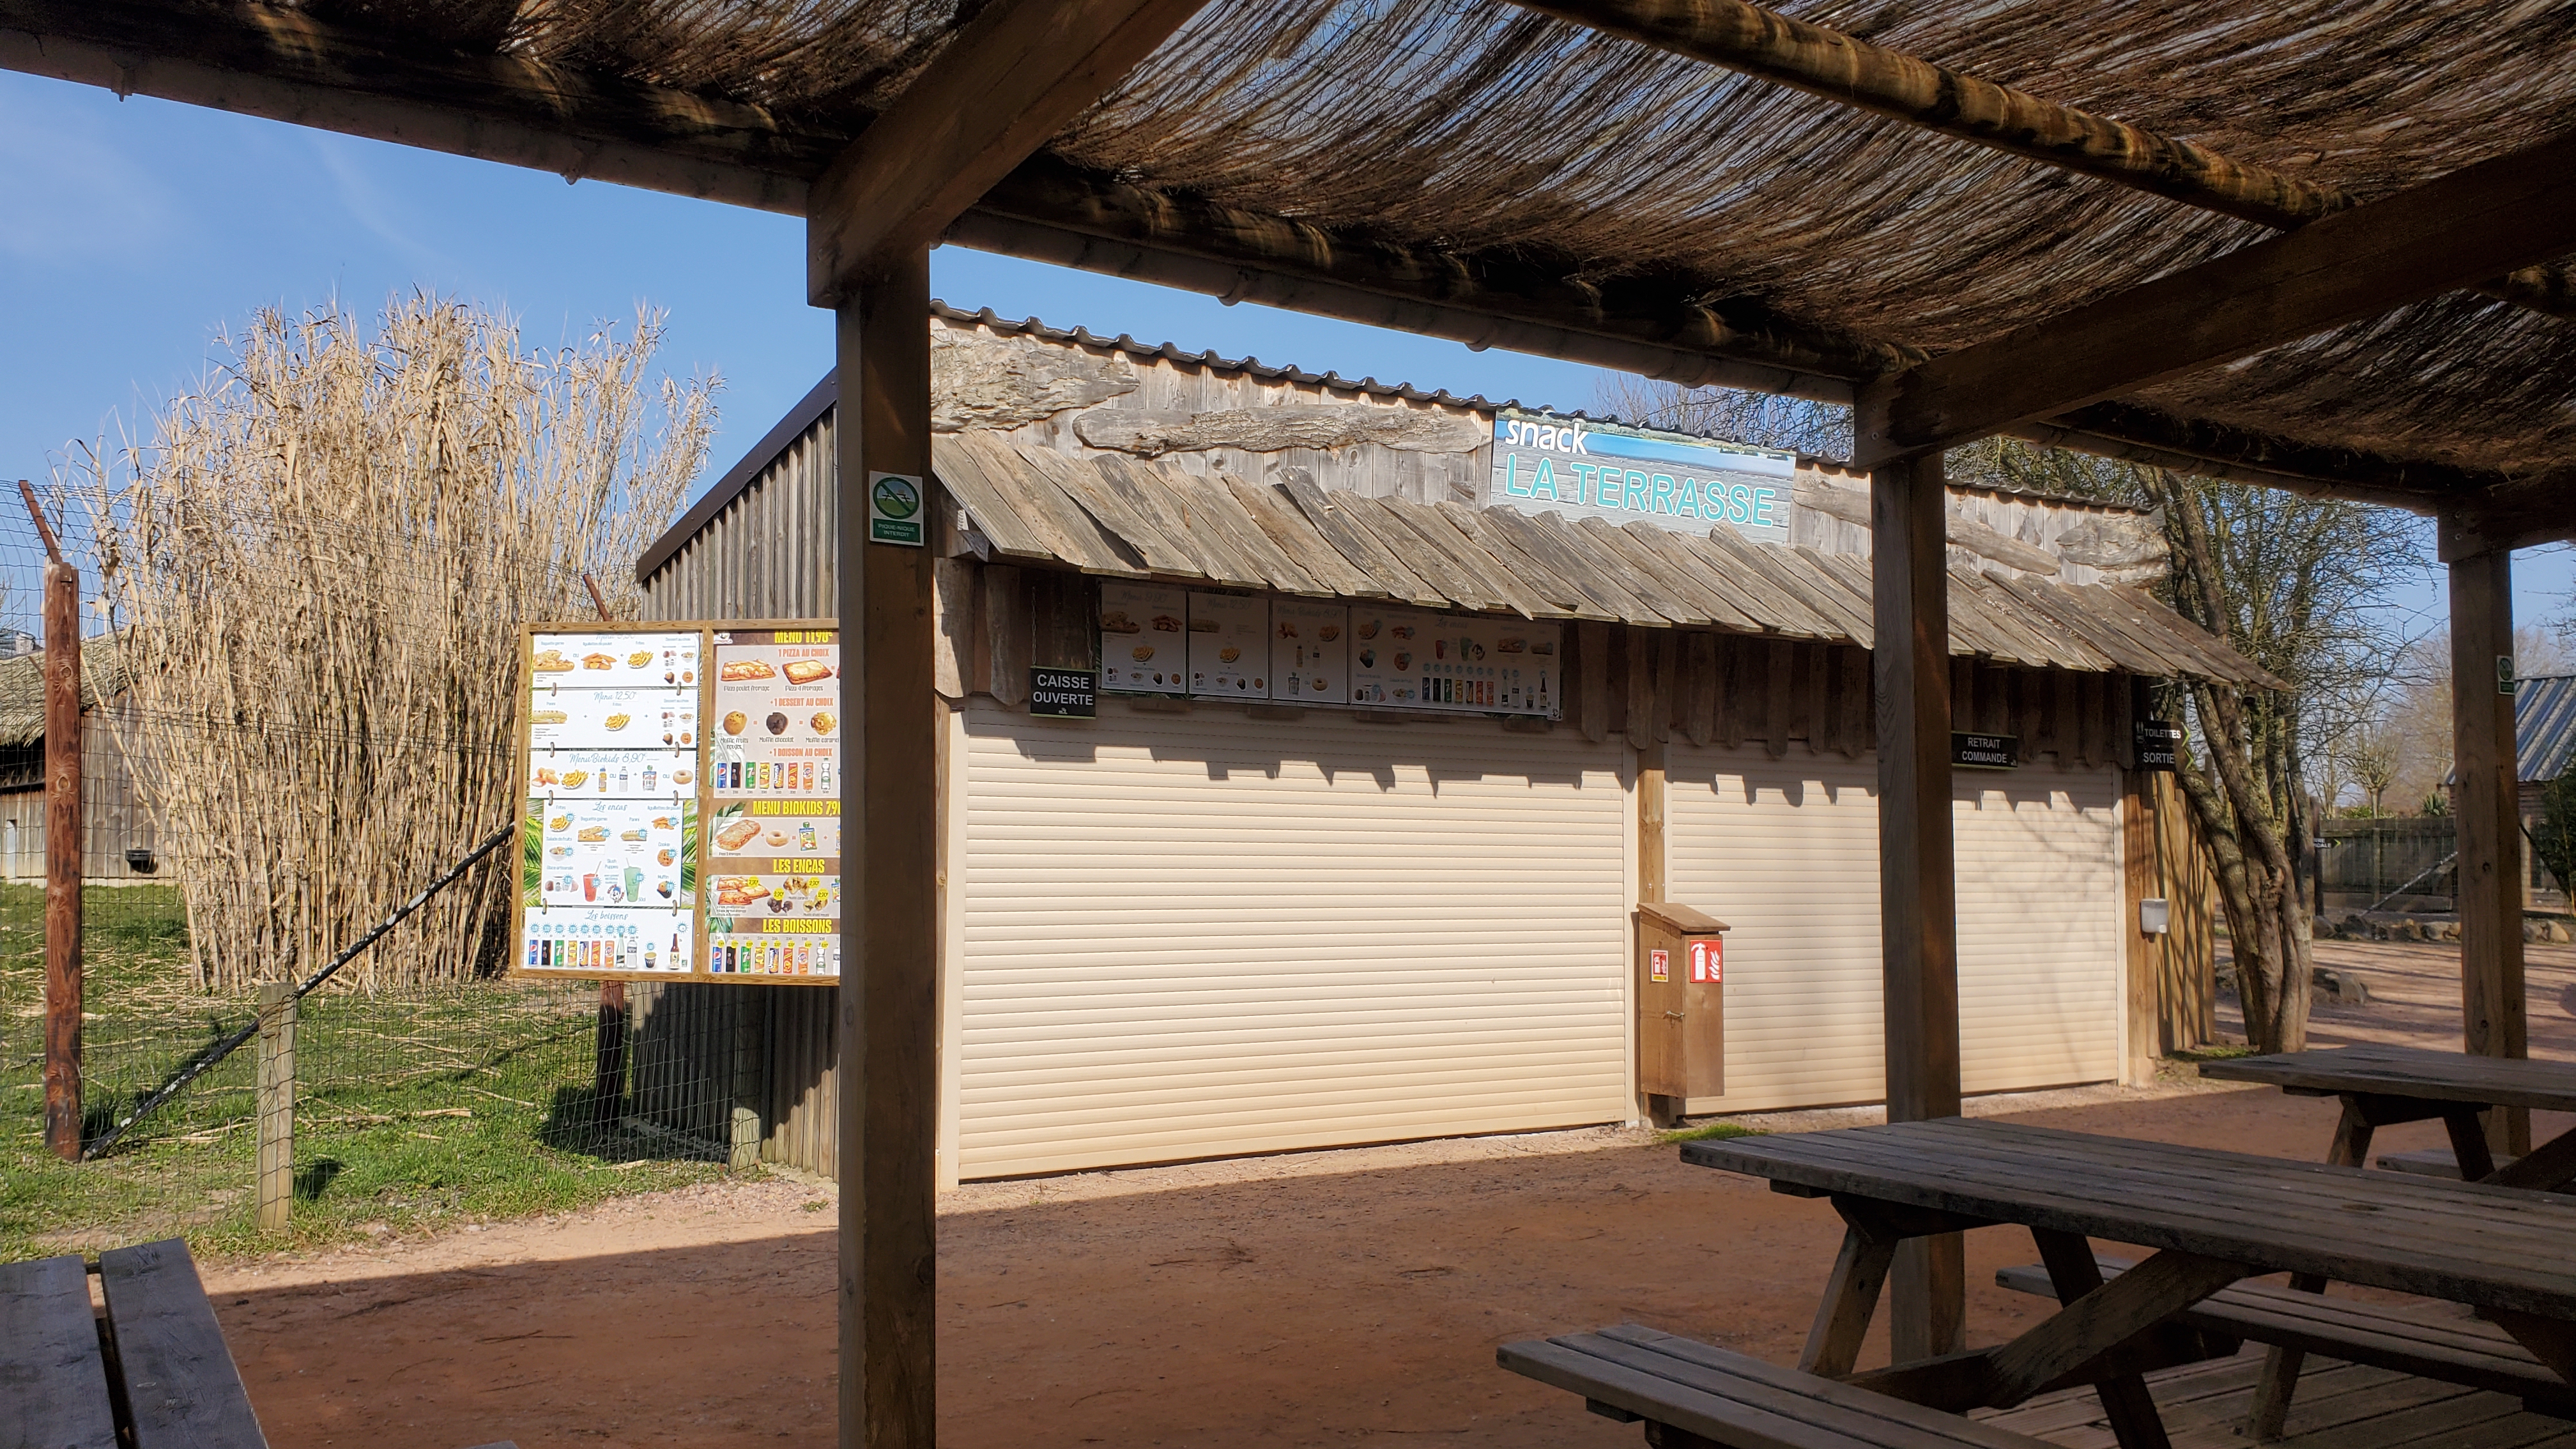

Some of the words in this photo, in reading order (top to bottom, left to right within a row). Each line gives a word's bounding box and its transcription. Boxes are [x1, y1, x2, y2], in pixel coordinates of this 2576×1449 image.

[1505, 419, 1589, 456] snack
[1505, 453, 1560, 502] LA
[1570, 462, 1776, 528] TERRASSE
[878, 523, 916, 532] PIQUE-NIQUE
[774, 630, 802, 643] MENU
[783, 648, 800, 657] PIZZA
[802, 648, 810, 657] AU
[811, 648, 829, 657] CHOIX
[1037, 674, 1089, 689] CAISSE
[594, 691, 614, 703] Menu
[779, 698, 804, 707] DESSERT
[806, 698, 814, 707] AU
[815, 698, 834, 707] CHOIX
[1032, 691, 1094, 705] OUVERTE
[2144, 728, 2182, 739] TOILETTES
[1968, 737, 2001, 749] RETRAIT
[778, 748, 804, 757] BOISSON
[804, 748, 813, 757] AU
[814, 748, 832, 757] CHOIX
[1961, 751, 2008, 763] COMMANDE
[2143, 752, 2175, 764] SORTIE
[569, 753, 590, 767] Menu
[591, 753, 620, 763] Biokids
[592, 801, 607, 813] Les
[607, 804, 627, 812] encas
[753, 801, 781, 815] MENU
[783, 801, 824, 815] BIOKIDS
[772, 859, 791, 873] LES
[793, 859, 825, 873] ENCAS
[584, 909, 599, 921] Les
[599, 910, 629, 920] boissons
[763, 919, 781, 933] LES
[783, 919, 832, 933] BOISSONS
